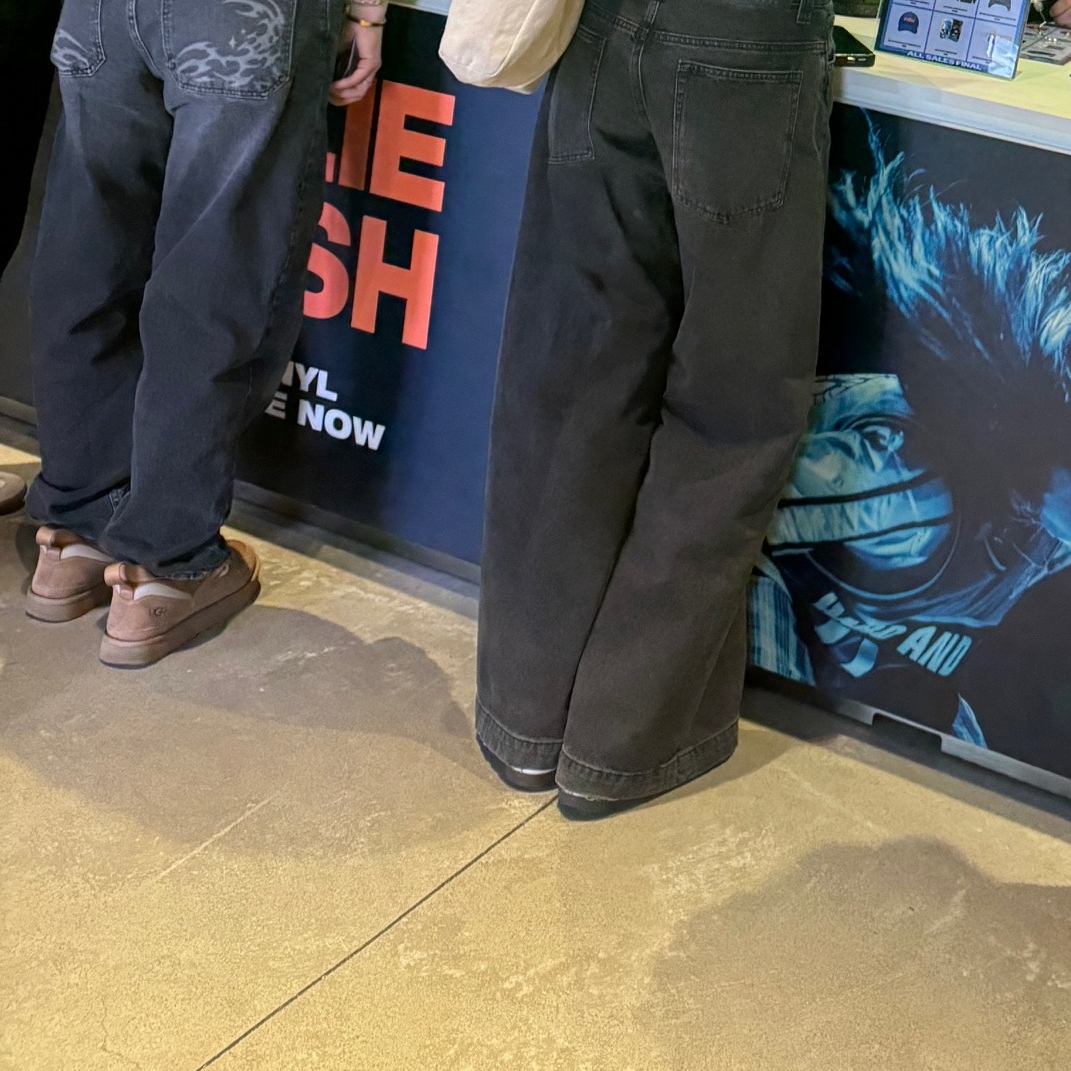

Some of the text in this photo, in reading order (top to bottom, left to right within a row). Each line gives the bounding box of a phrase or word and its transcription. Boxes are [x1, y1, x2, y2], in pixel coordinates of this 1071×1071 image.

[906, 50, 925, 59] ALL
[925, 53, 955, 66] SALES
[955, 59, 982, 71] FINAL
[297, 398, 386, 451] NOW
